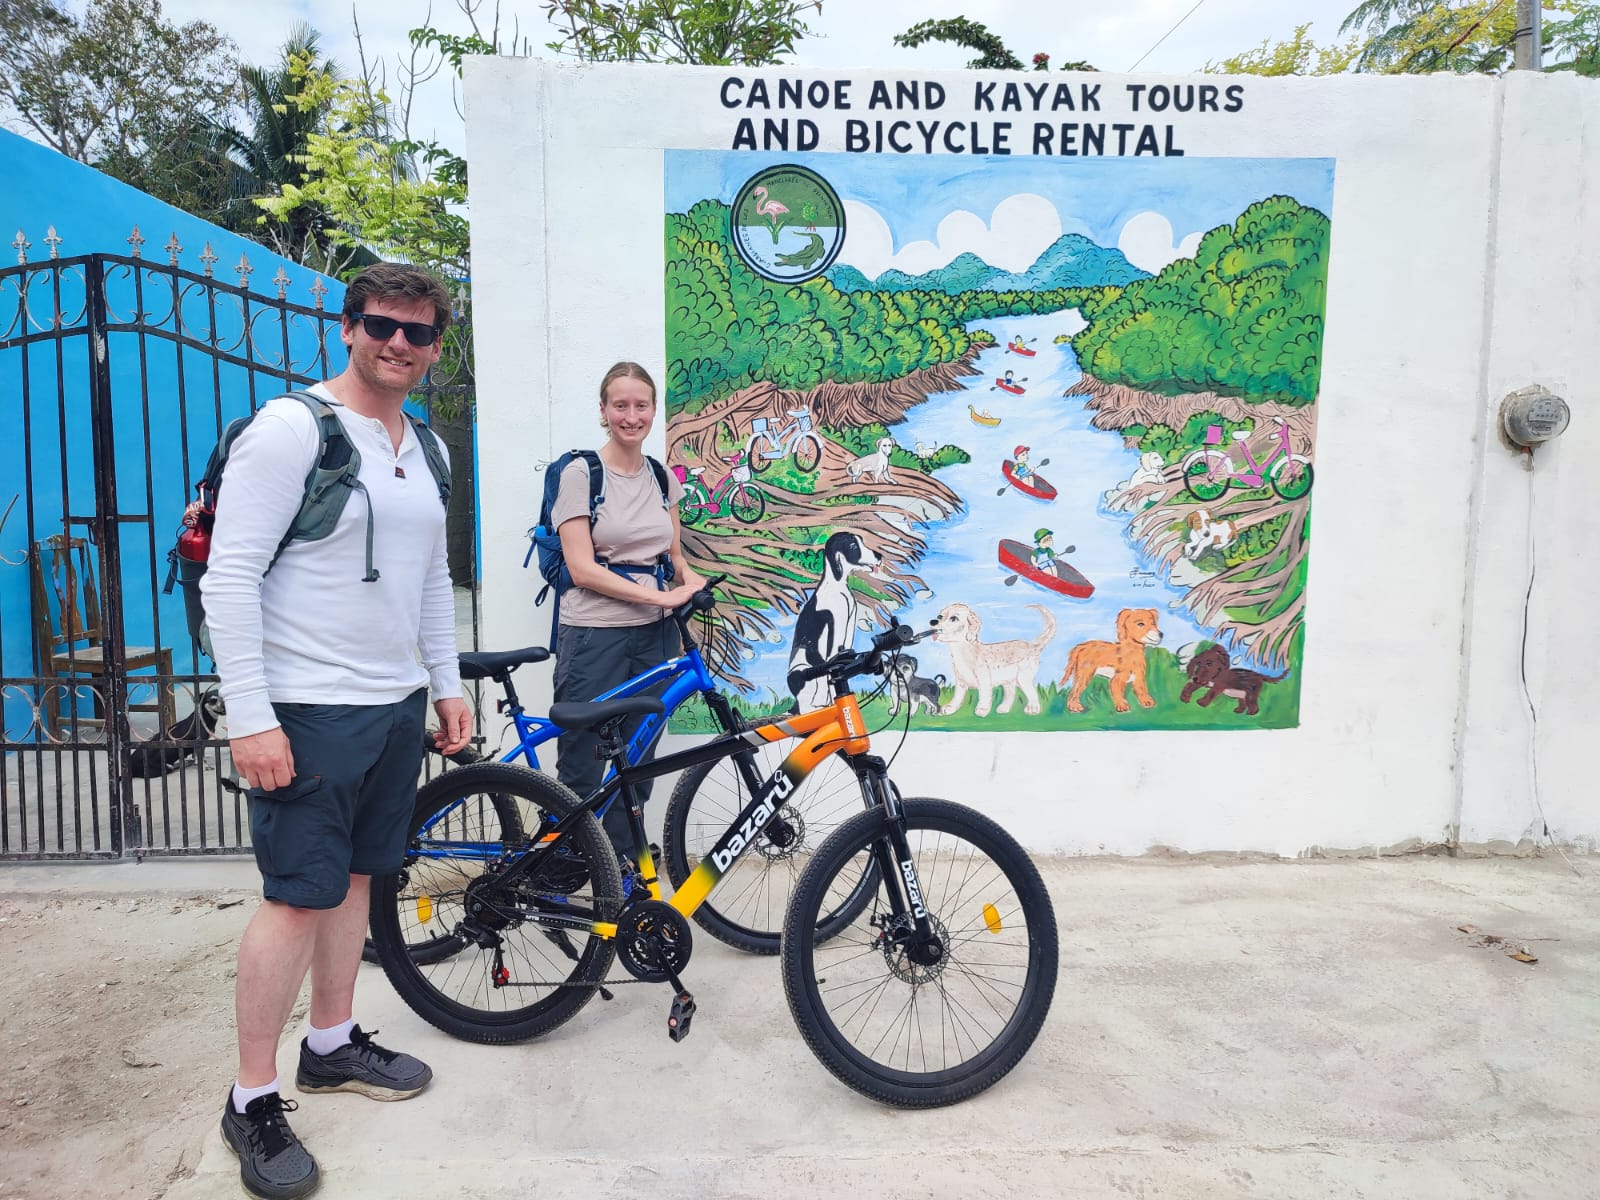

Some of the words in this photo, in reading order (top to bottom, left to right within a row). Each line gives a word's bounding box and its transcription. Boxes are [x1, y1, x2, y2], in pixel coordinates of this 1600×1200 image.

[720, 76, 852, 110] CANOE
[868, 79, 946, 110] AND
[974, 81, 1101, 113] KAYAK
[1126, 84, 1244, 113] TOURS
[731, 117, 820, 152] AND
[845, 119, 1012, 156] BICYCLE
[1032, 122, 1185, 157] RENTAL
